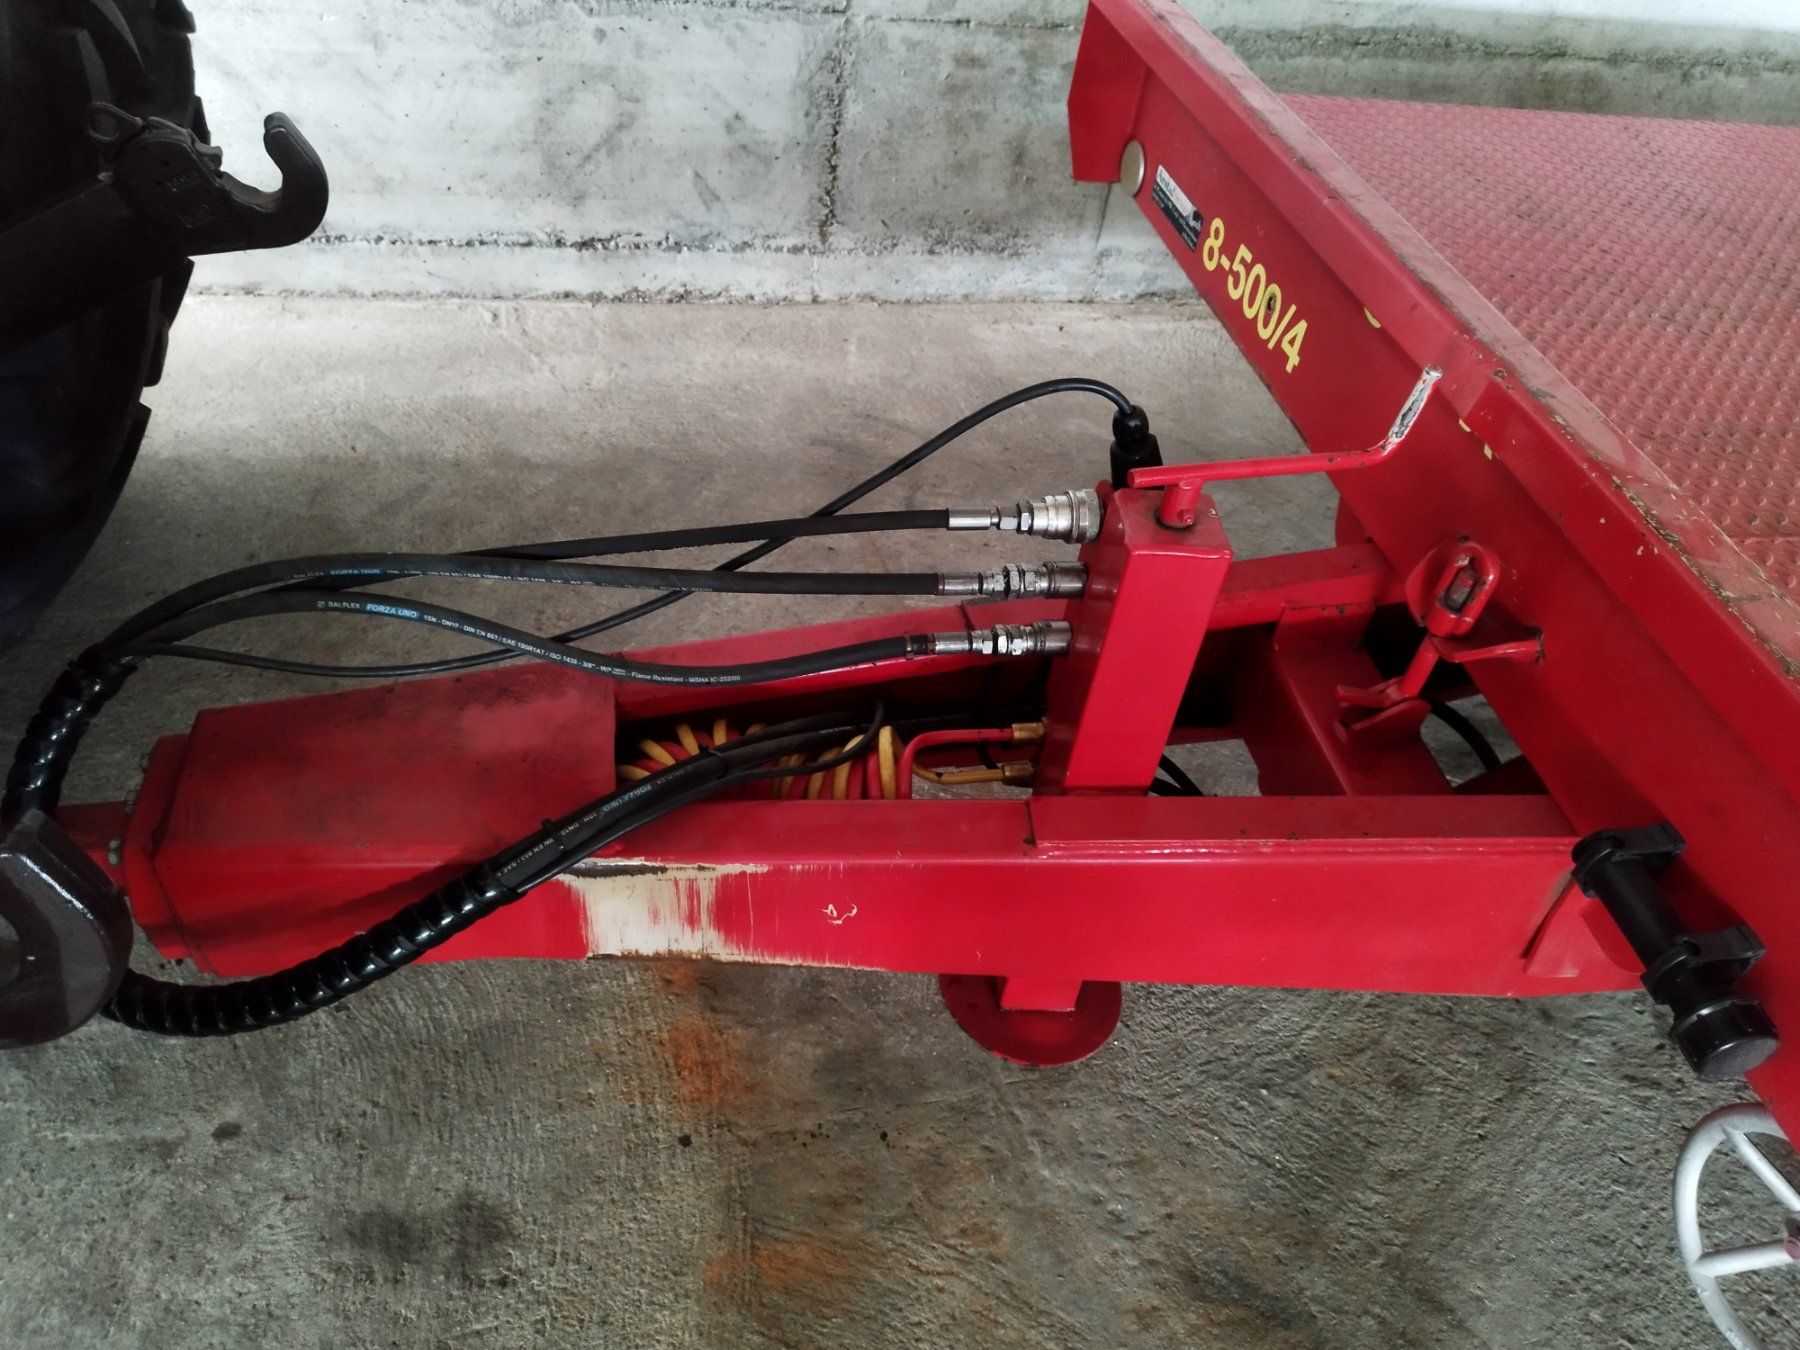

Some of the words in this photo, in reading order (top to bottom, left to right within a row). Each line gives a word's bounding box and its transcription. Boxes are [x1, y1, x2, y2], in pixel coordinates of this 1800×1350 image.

[1203, 218, 1307, 373] 8-500/4
[328, 601, 361, 609] BALFLEX
[366, 603, 396, 614] FORZA
[398, 608, 418, 618] UNO
[502, 637, 516, 646] SAE
[630, 671, 651, 680] Flame
[652, 674, 684, 682] Resistant
